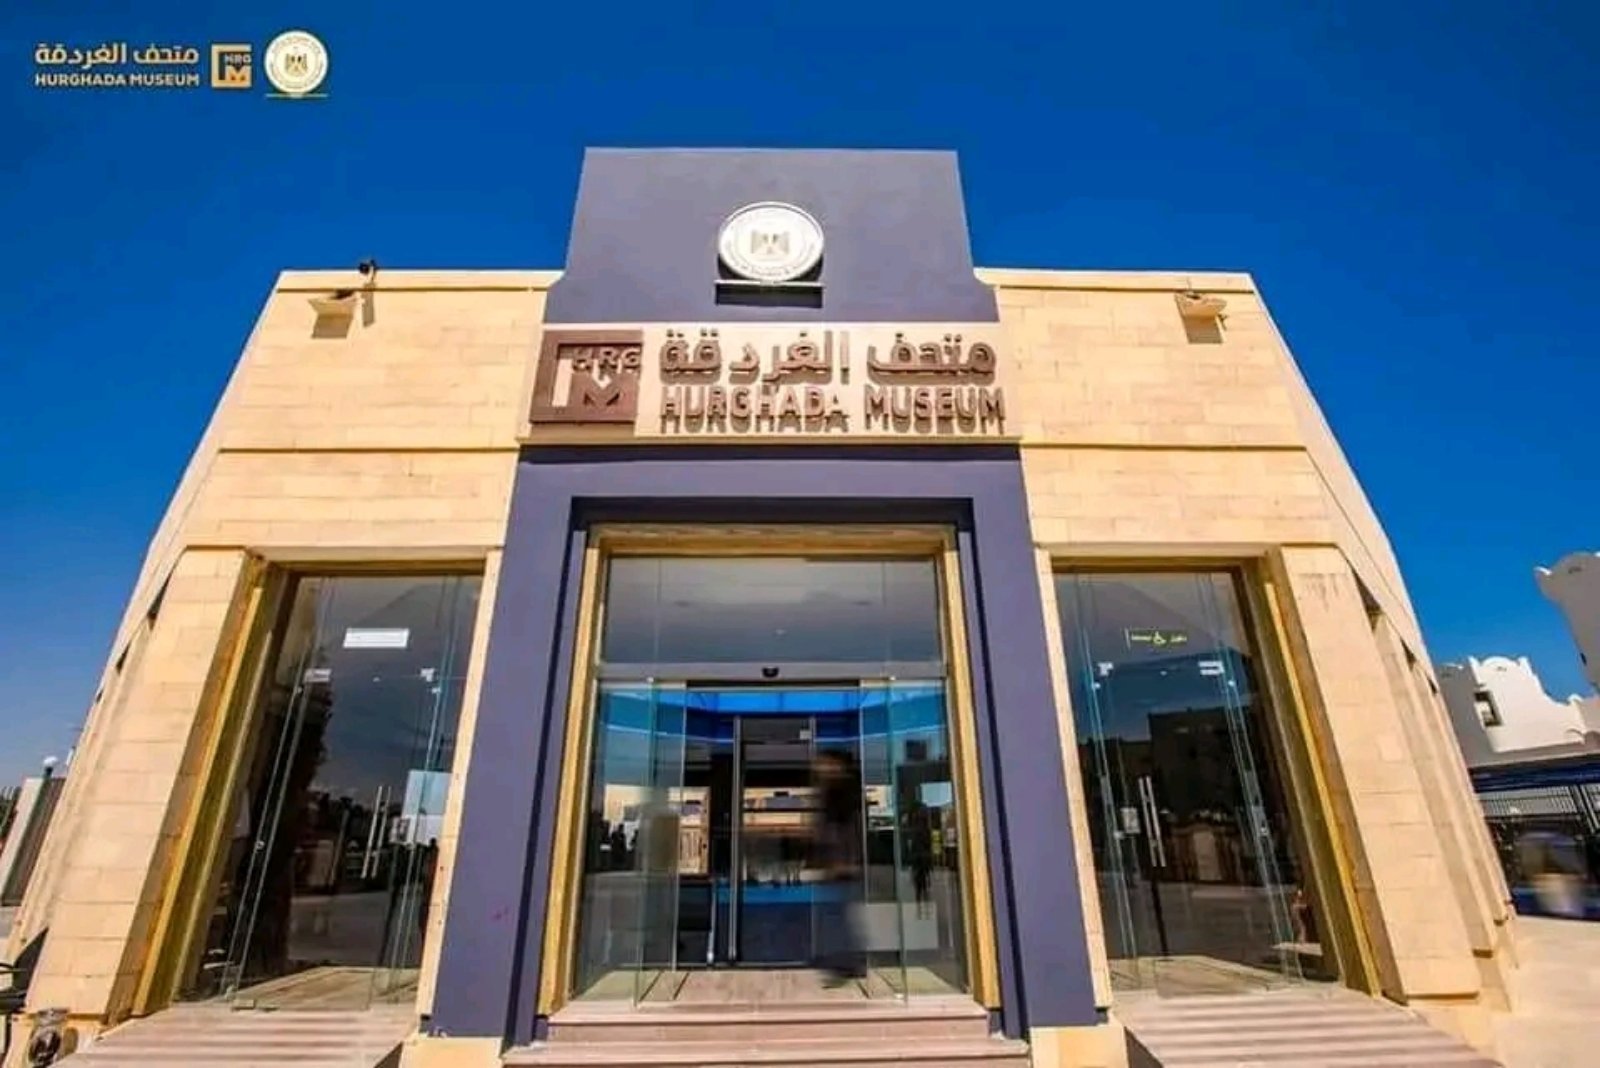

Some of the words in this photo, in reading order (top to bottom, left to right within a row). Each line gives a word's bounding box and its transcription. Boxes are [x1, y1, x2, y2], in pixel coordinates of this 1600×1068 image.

[659, 329, 850, 385] الغردقة
[866, 333, 997, 377] متحف
[660, 385, 850, 425] HURGHADA
[864, 385, 1006, 426] MUSEUM
